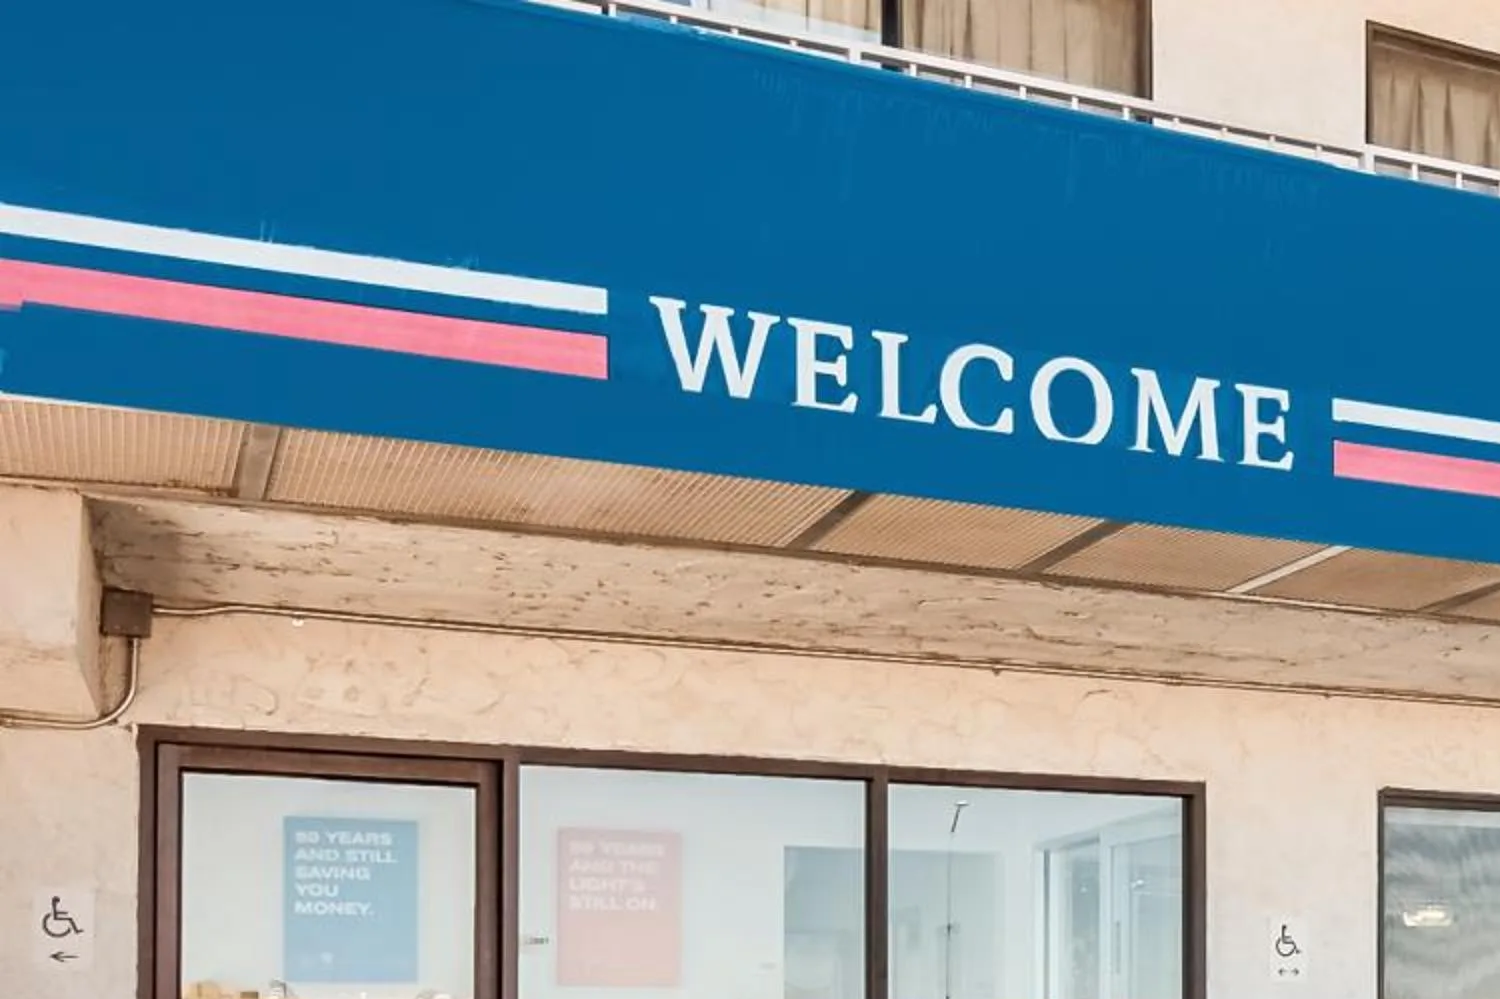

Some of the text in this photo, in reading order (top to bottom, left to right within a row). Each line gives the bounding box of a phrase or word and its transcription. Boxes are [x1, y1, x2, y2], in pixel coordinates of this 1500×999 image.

[649, 296, 1294, 471] WELCOME
[325, 830, 392, 846] YEARS
[295, 848, 399, 863] AND STILL
[295, 866, 371, 880] SAVING
[294, 882, 339, 897] YOU
[295, 900, 375, 916] MONEY.
[568, 895, 623, 910] STILL
